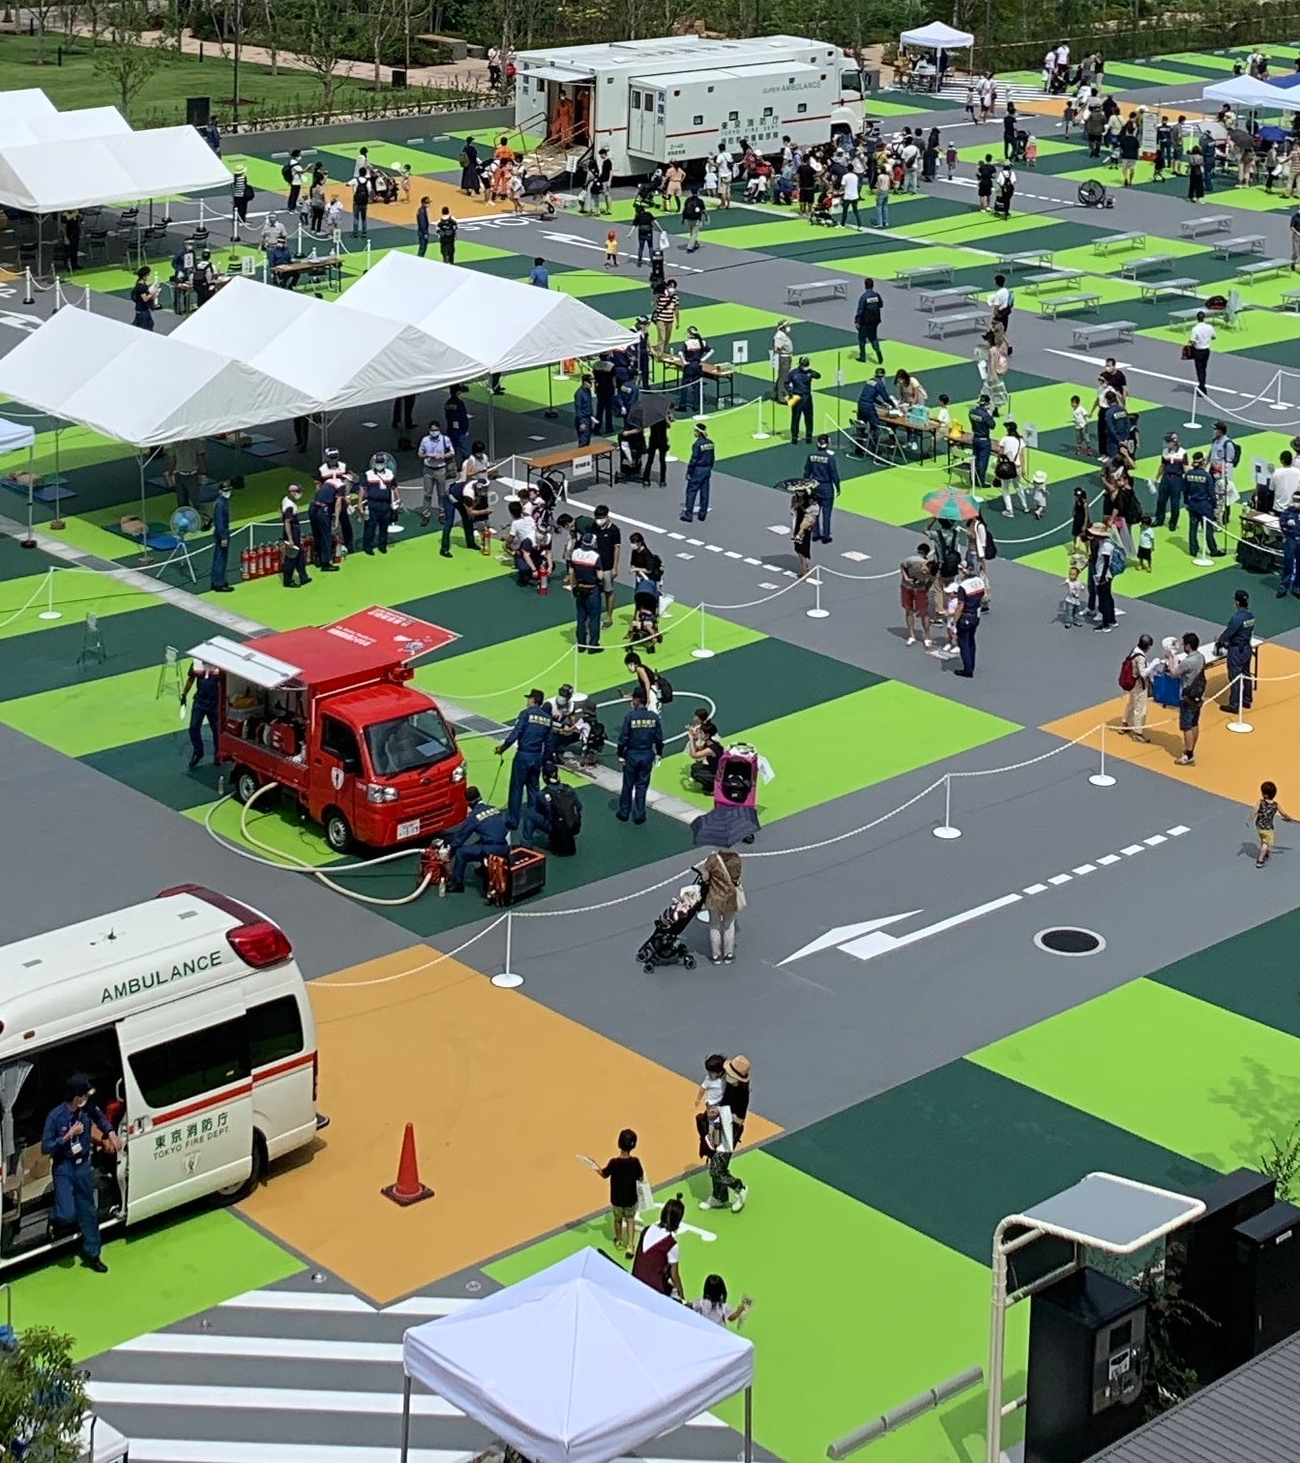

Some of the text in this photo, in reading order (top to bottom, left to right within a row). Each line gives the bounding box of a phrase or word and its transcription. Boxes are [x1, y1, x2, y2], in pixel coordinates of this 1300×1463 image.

[781, 80, 821, 92] AMBULANCE
[721, 115, 779, 130] 東京消防庁
[101, 950, 223, 1004] AMBULANCE
[153, 1126, 230, 1161] TOKYO FIRE DEPT
[155, 1111, 229, 1150] 東京消防庁
